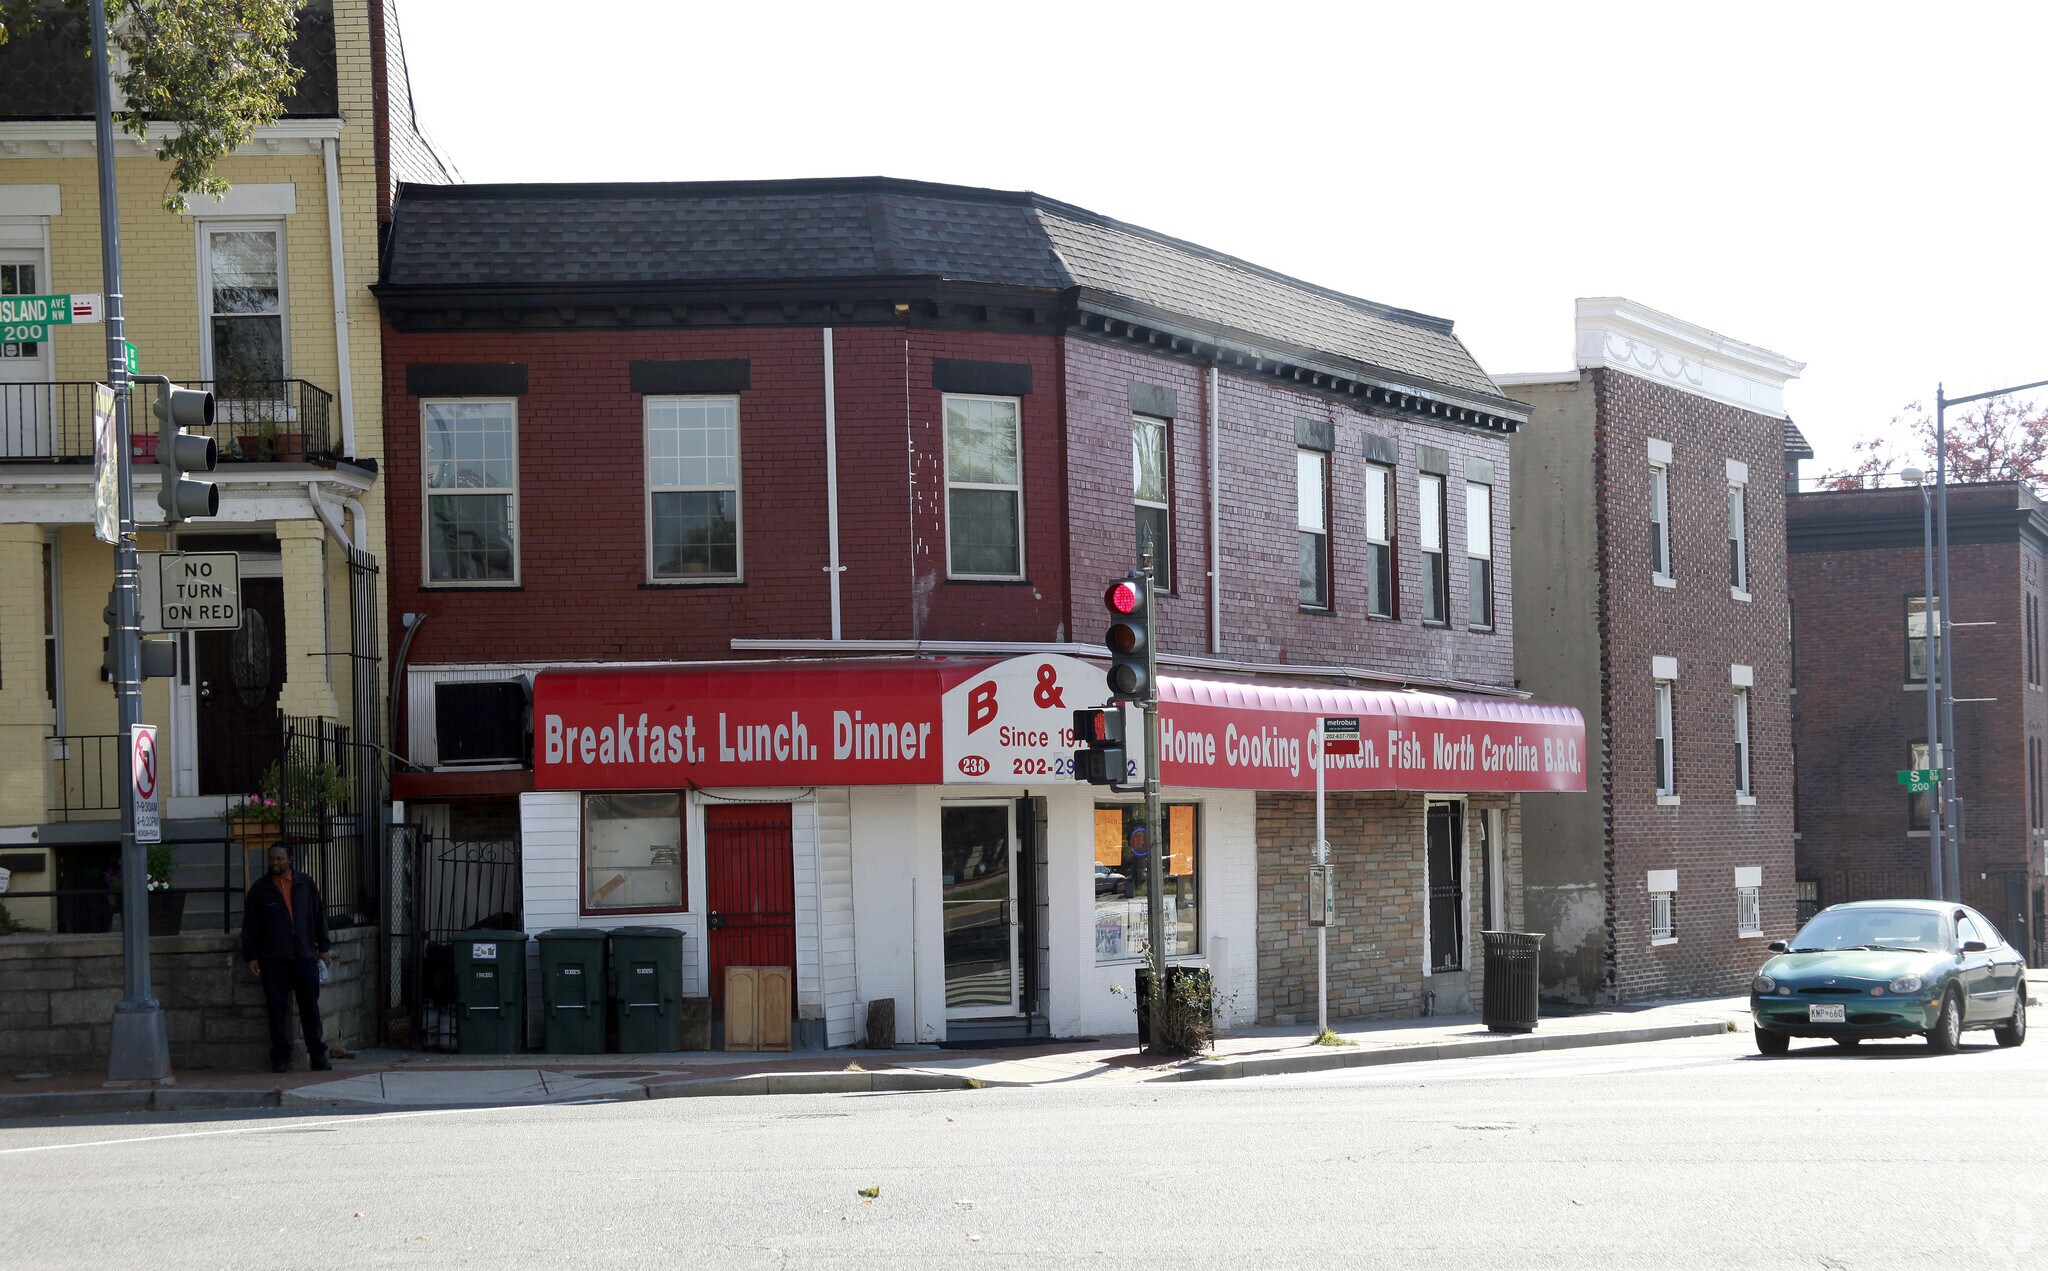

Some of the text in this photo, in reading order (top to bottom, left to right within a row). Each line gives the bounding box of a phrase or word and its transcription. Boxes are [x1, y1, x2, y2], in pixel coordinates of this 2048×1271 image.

[51, 298, 66, 308] AVE
[52, 310, 65, 320] NW
[4, 325, 43, 341] 200
[185, 562, 212, 577] NO
[176, 584, 222, 599] TURN
[168, 605, 234, 620] ON RED
[967, 663, 1067, 736] B &
[545, 710, 931, 764] Breakfast. Lunch. Dinner
[999, 725, 1091, 748] Since 19
[1160, 718, 1216, 766] Home
[1225, 722, 1300, 778] Cooking
[1307, 728, 1380, 769] Cen.
[1388, 729, 1426, 770] Fish.
[1433, 732, 1475, 771] North
[1481, 734, 1538, 772] Carolina
[963, 759, 986, 773] 238
[1910, 771, 1920, 782] S
[1911, 783, 1930, 792] 200
